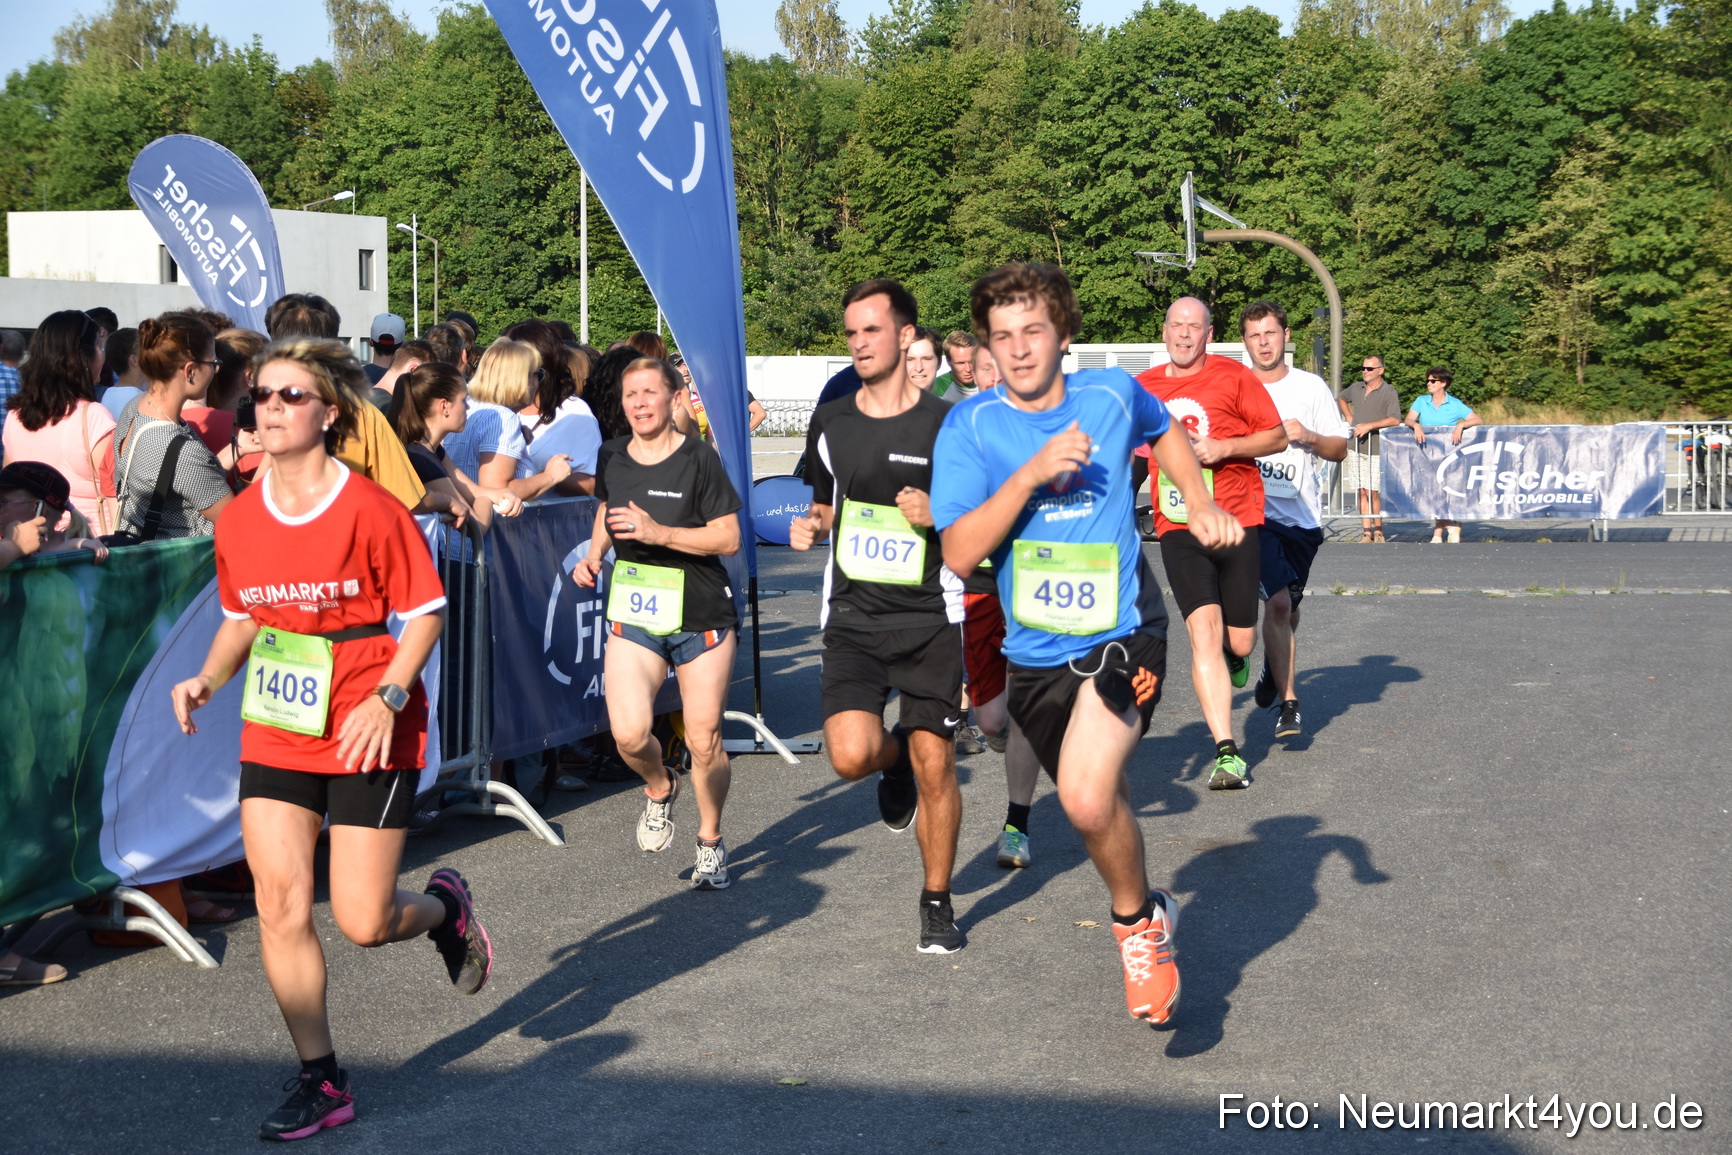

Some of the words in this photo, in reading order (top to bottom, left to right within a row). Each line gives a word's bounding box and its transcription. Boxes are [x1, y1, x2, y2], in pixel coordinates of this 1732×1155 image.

[896, 454, 928, 465] PFLEIDERER
[1466, 464, 1604, 490] Fischer
[766, 505, 783, 516] und
[784, 503, 799, 513] das
[1027, 491, 1093, 511] camping
[1478, 493, 1593, 505] AUTOMOBILE
[849, 534, 916, 563] 1067
[239, 582, 338, 606] NEUMARKT
[630, 592, 659, 616] 94
[1034, 579, 1096, 609] 498
[256, 665, 318, 707] 1408
